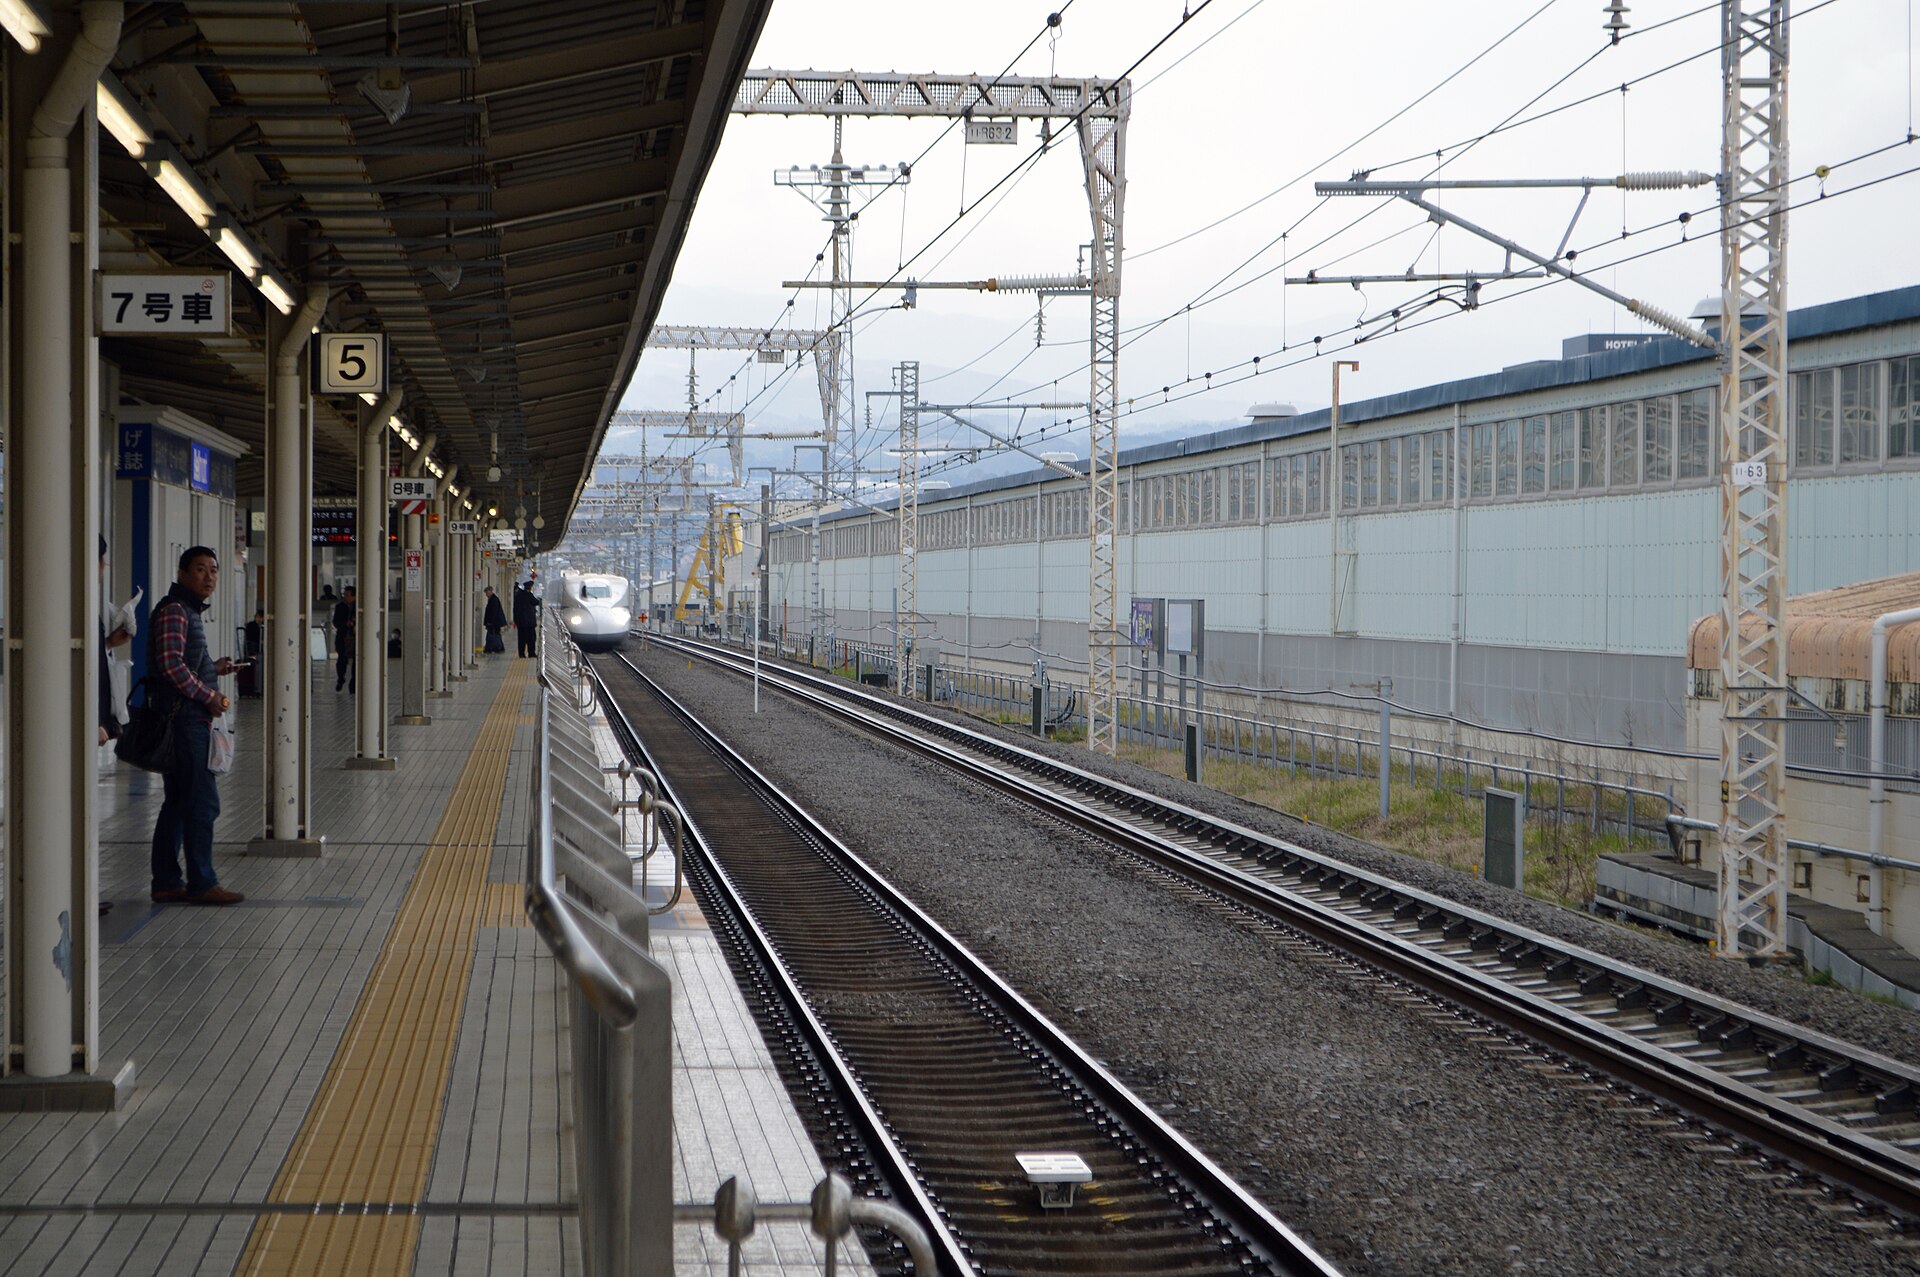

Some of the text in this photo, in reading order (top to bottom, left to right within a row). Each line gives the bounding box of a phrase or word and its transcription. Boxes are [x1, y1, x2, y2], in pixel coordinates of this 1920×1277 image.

[111, 292, 213, 324] 7号車
[338, 344, 367, 381] 5
[393, 482, 425, 495] 8号車
[450, 523, 475, 532] 9号車
